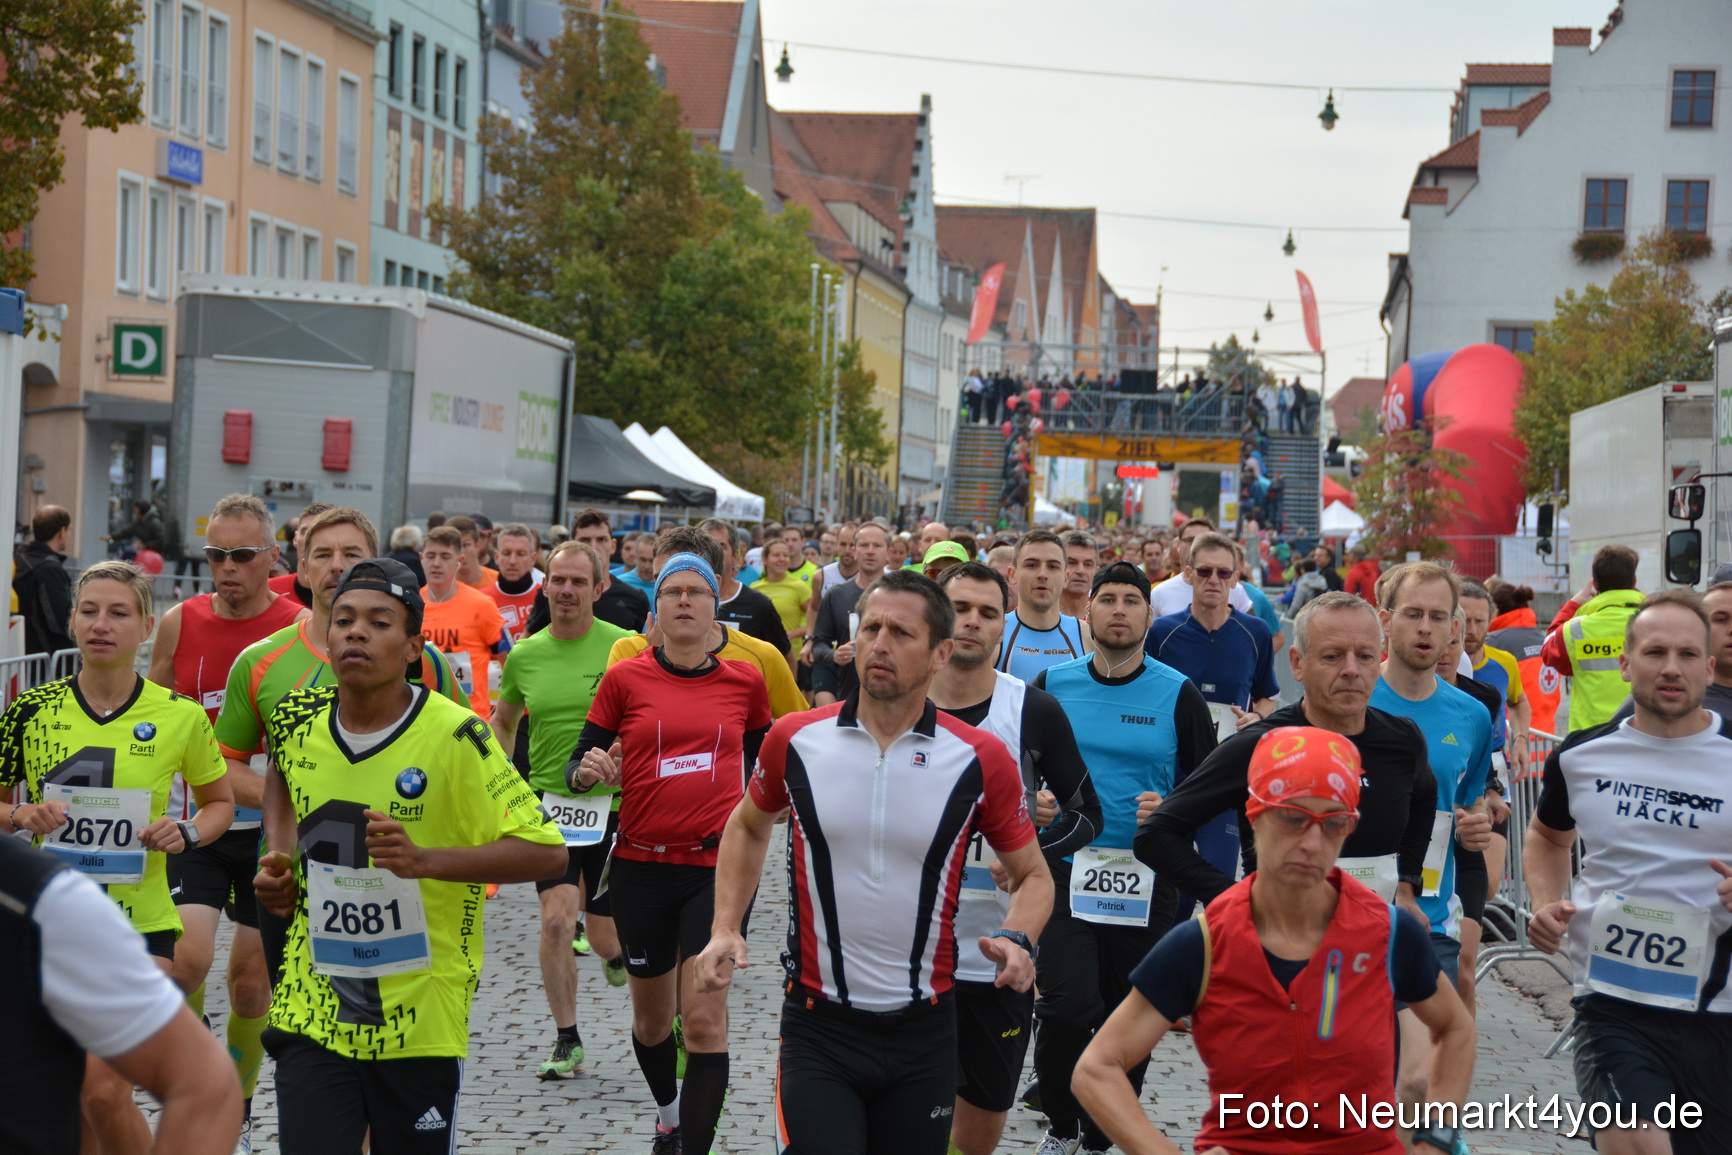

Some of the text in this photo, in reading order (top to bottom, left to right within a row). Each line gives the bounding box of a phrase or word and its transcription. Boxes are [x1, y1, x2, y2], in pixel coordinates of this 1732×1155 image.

[121, 331, 157, 369] D
[1116, 438, 1161, 458] ZIEL
[1121, 714, 1156, 726] THULE
[130, 743, 156, 753] Partl
[674, 758, 699, 770] DEHN
[1613, 781, 1724, 814] INTERSPORT
[389, 801, 424, 816] Partl
[550, 805, 598, 828] 2580
[1616, 800, 1699, 829] HÄCKL
[59, 817, 133, 848] 2670
[79, 855, 105, 867] Julia
[1083, 868, 1141, 895] 2652
[1097, 901, 1126, 912] Patrick
[322, 898, 402, 936] 2681
[353, 946, 379, 960] Nico
[1604, 923, 1687, 968] 2762
[415, 1119, 447, 1130] adidas
